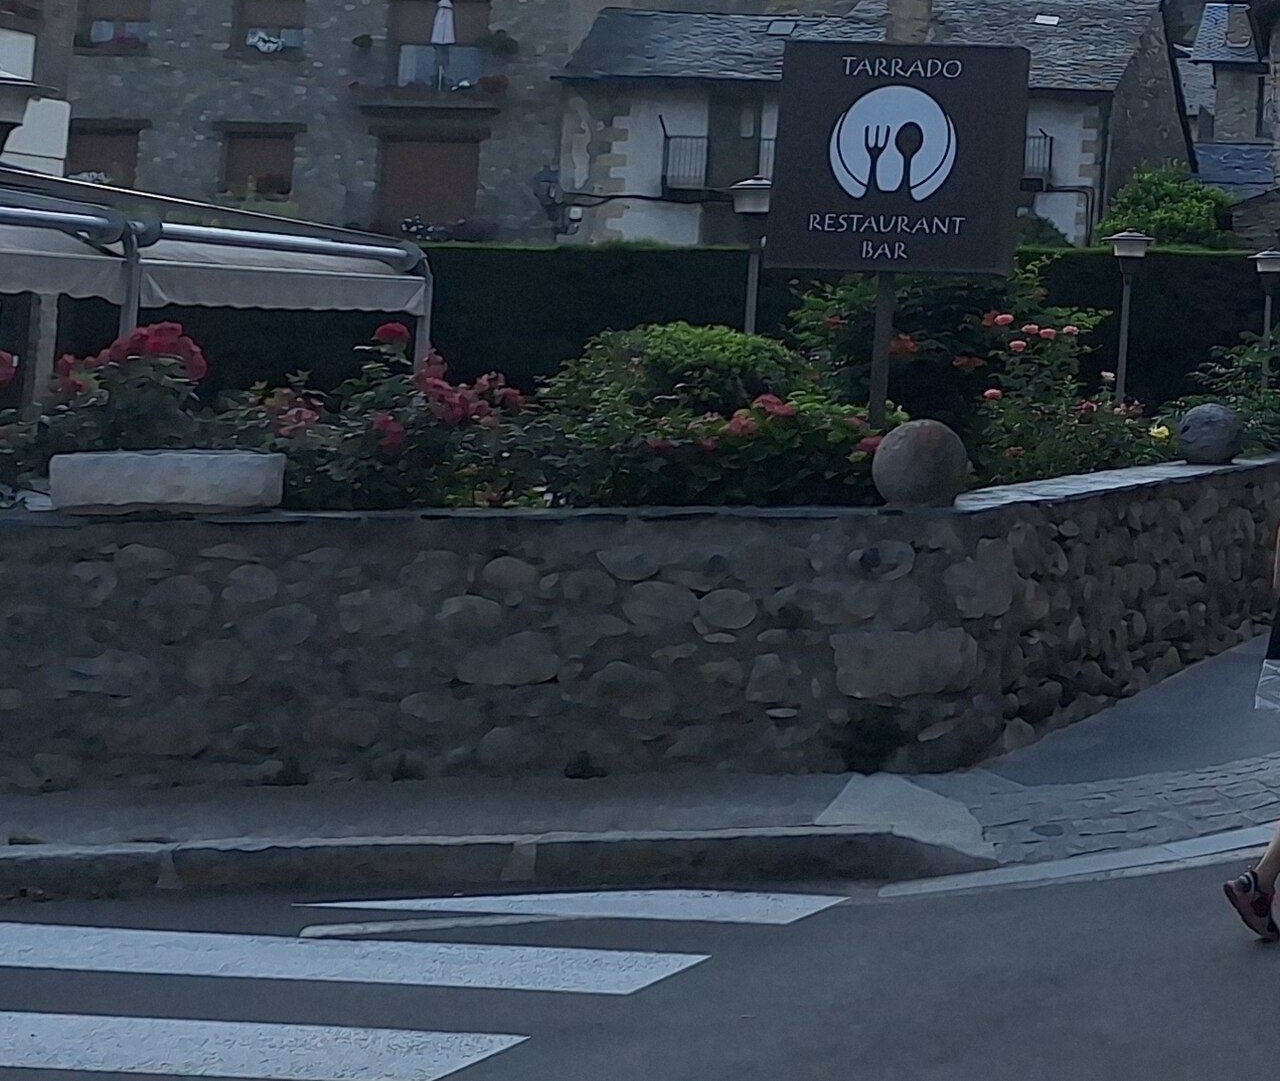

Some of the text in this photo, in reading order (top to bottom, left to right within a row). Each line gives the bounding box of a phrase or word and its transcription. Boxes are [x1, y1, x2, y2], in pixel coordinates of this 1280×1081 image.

[842, 56, 962, 78] TARRADO
[808, 214, 965, 235] RESTAURANT
[861, 241, 908, 259] BAR
